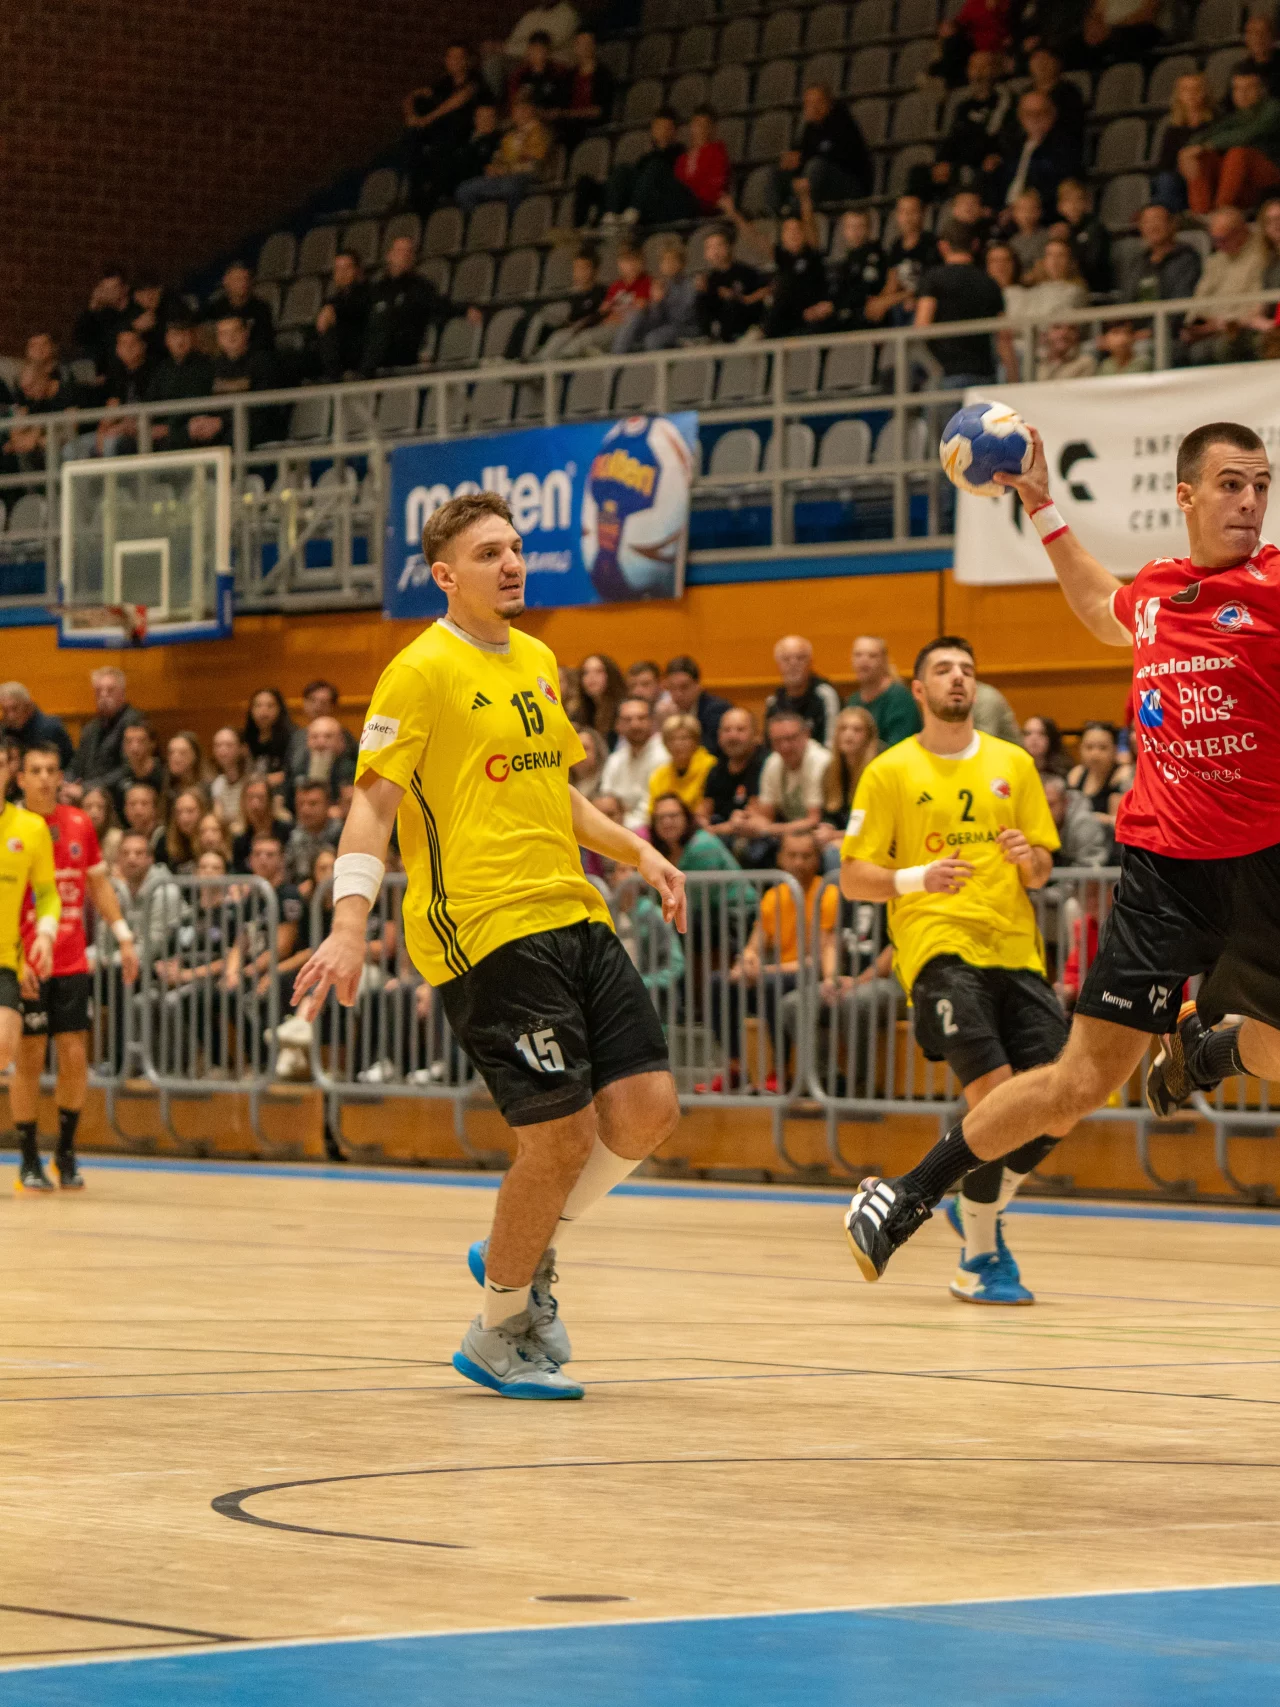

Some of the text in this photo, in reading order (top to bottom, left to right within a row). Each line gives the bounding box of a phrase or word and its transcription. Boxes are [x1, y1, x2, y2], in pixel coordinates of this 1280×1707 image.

[404, 464, 572, 546] mten
[1177, 681, 1223, 704] biro
[510, 690, 546, 738] 15
[958, 788, 976, 823] 2
[936, 998, 959, 1035] 2
[1102, 990, 1133, 1010] Kempa
[514, 1027, 565, 1073] 15
